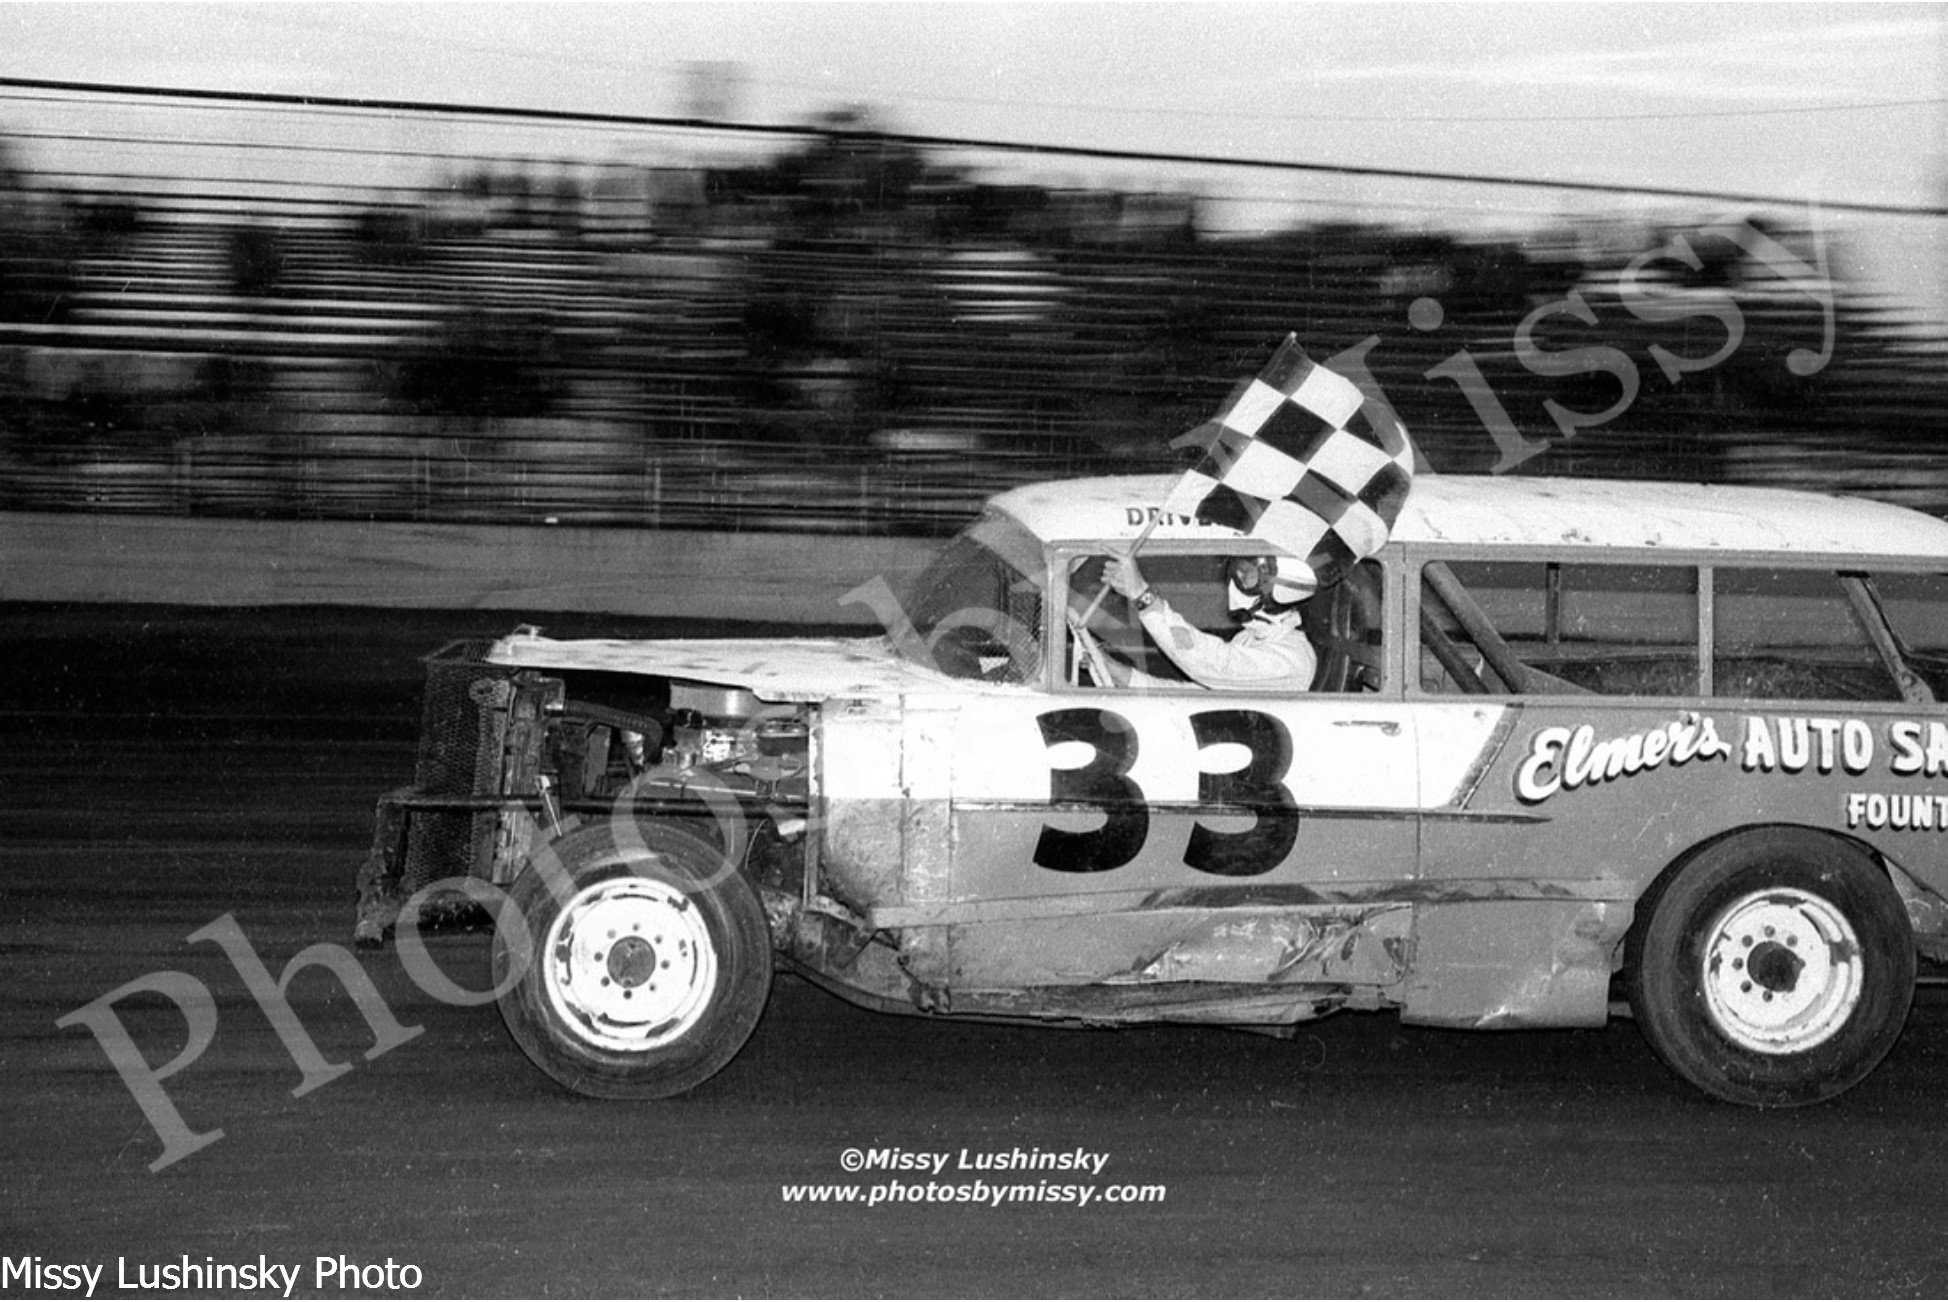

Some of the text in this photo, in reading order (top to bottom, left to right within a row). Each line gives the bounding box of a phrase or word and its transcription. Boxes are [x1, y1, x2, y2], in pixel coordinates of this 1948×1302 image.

[1033, 707, 1300, 877] 33
[1514, 711, 1732, 804] Elmer's
[1740, 716, 1874, 775] AUTO
